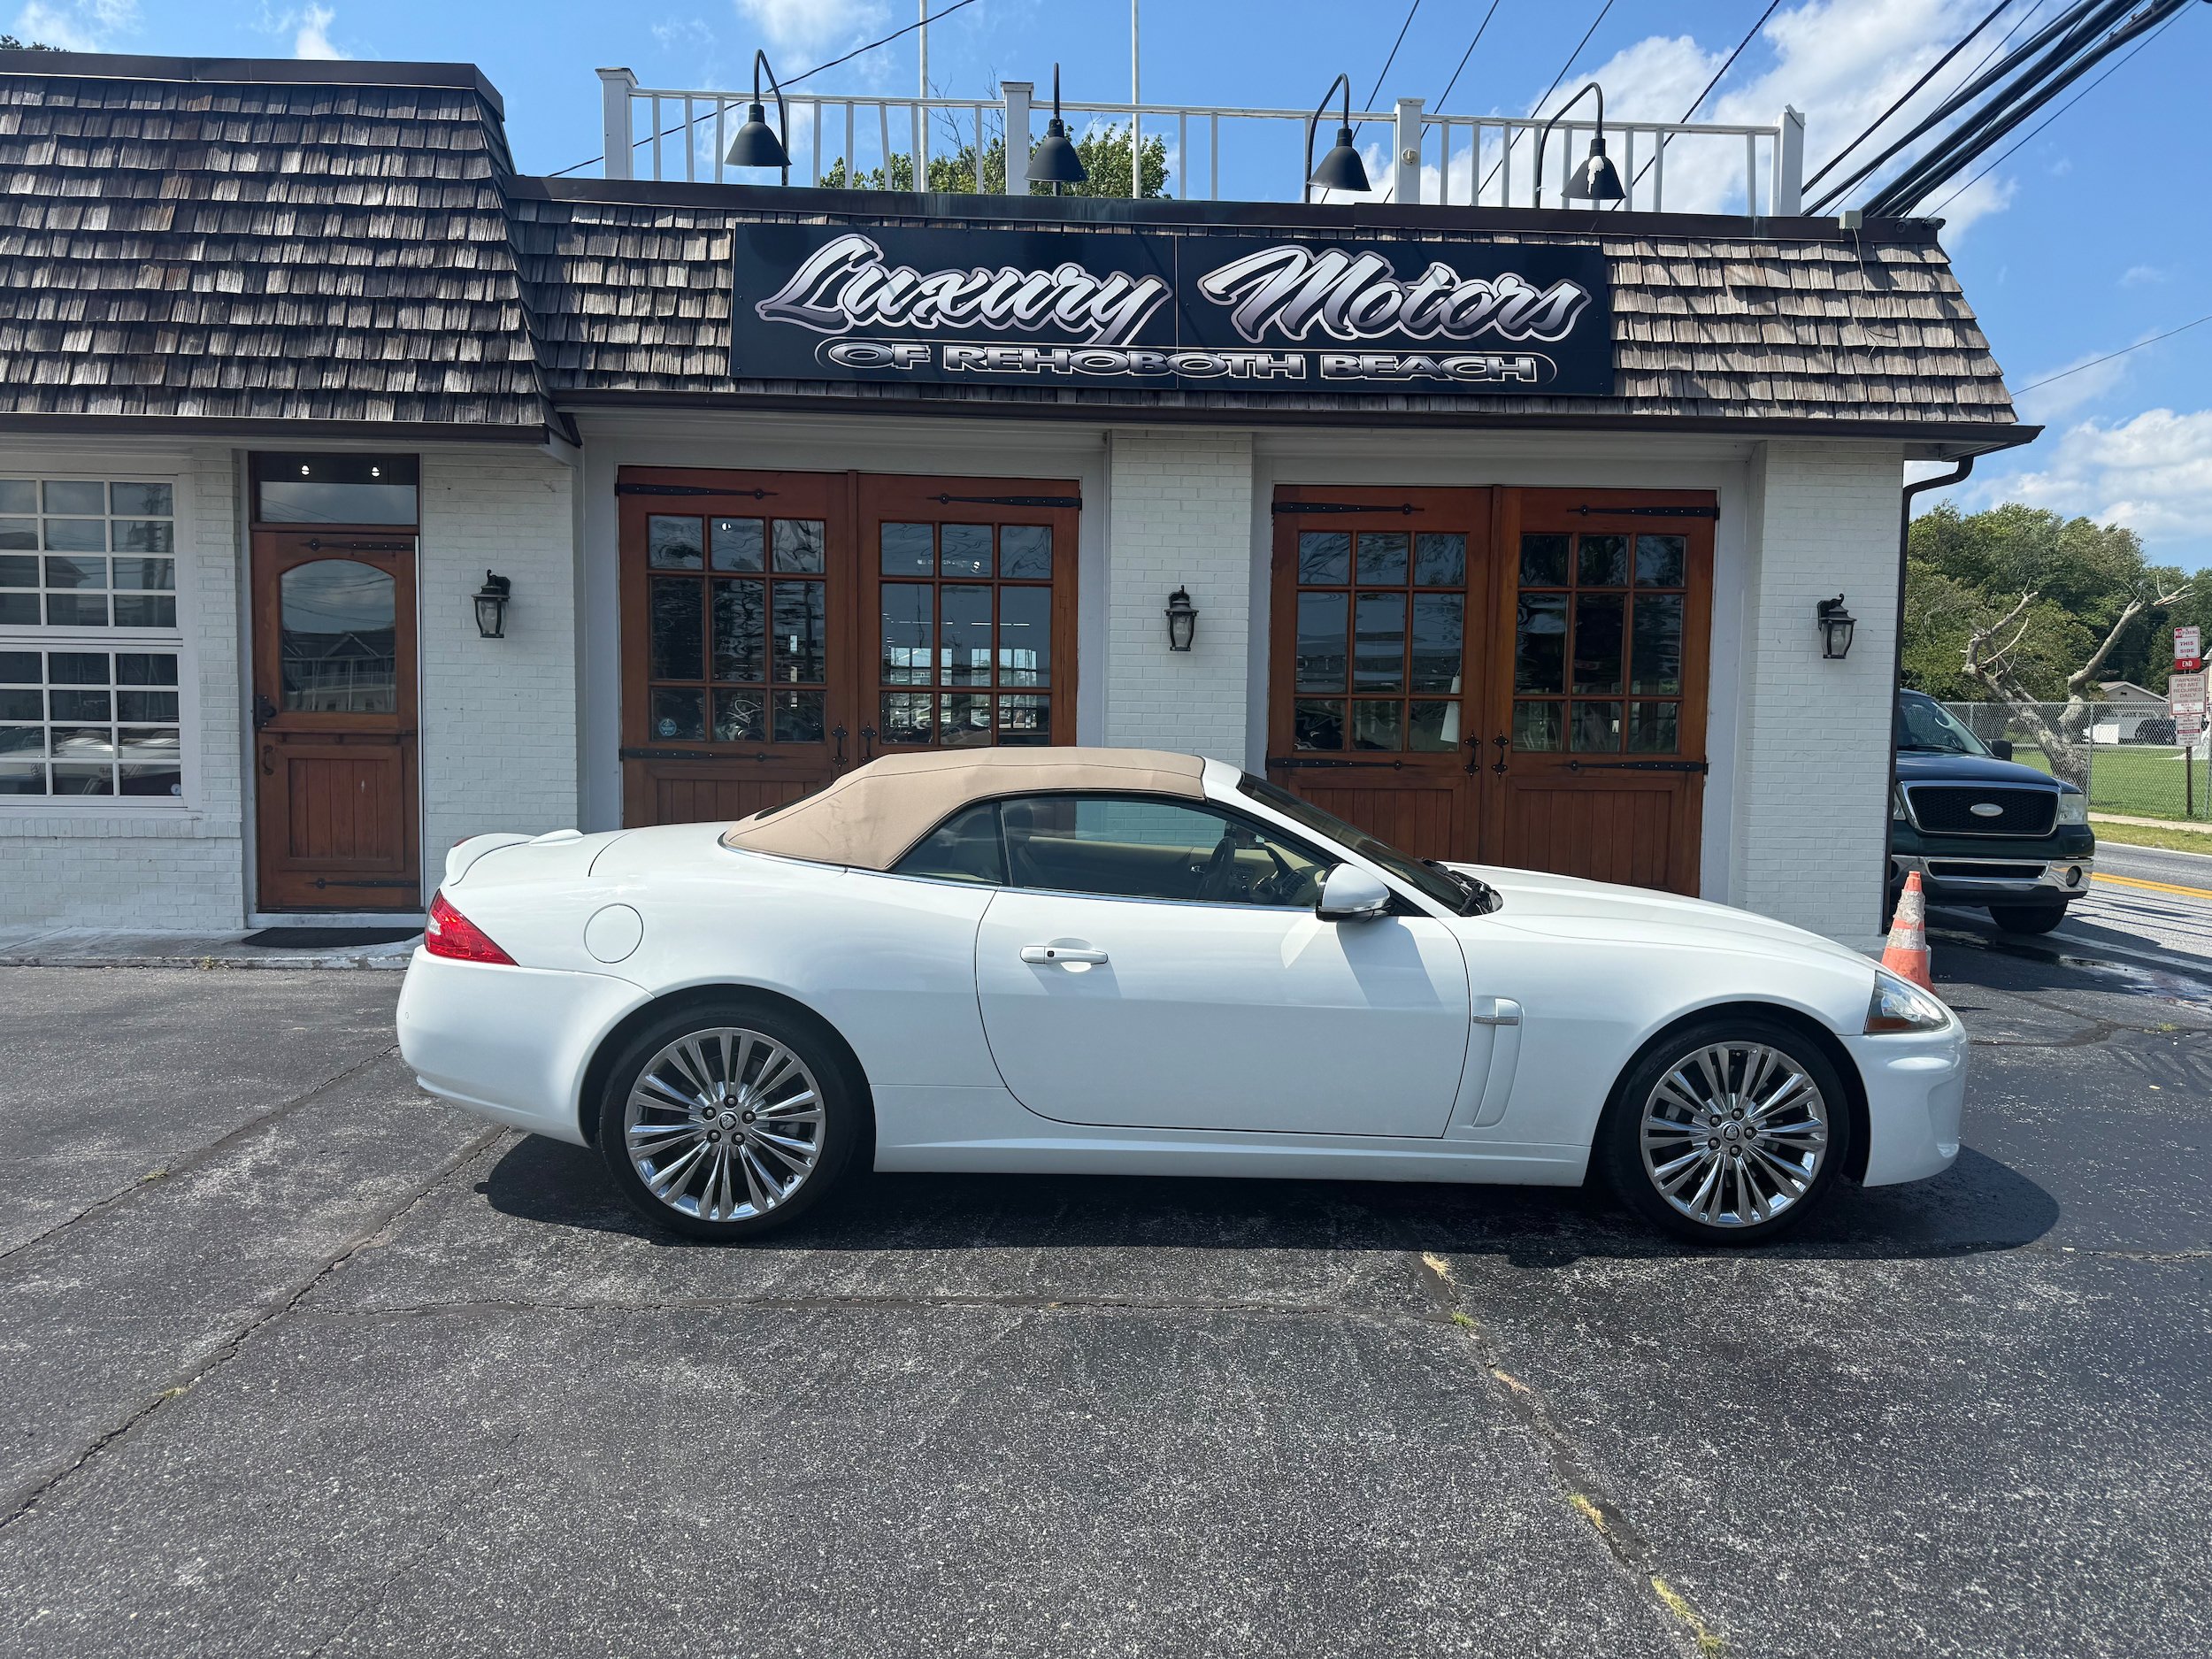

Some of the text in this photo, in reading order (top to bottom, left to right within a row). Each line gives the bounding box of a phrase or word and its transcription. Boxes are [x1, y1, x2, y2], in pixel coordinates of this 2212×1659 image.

[756, 234, 1592, 347] Luxury Motors
[828, 342, 1538, 383] OF REHOBOTH BEACH
